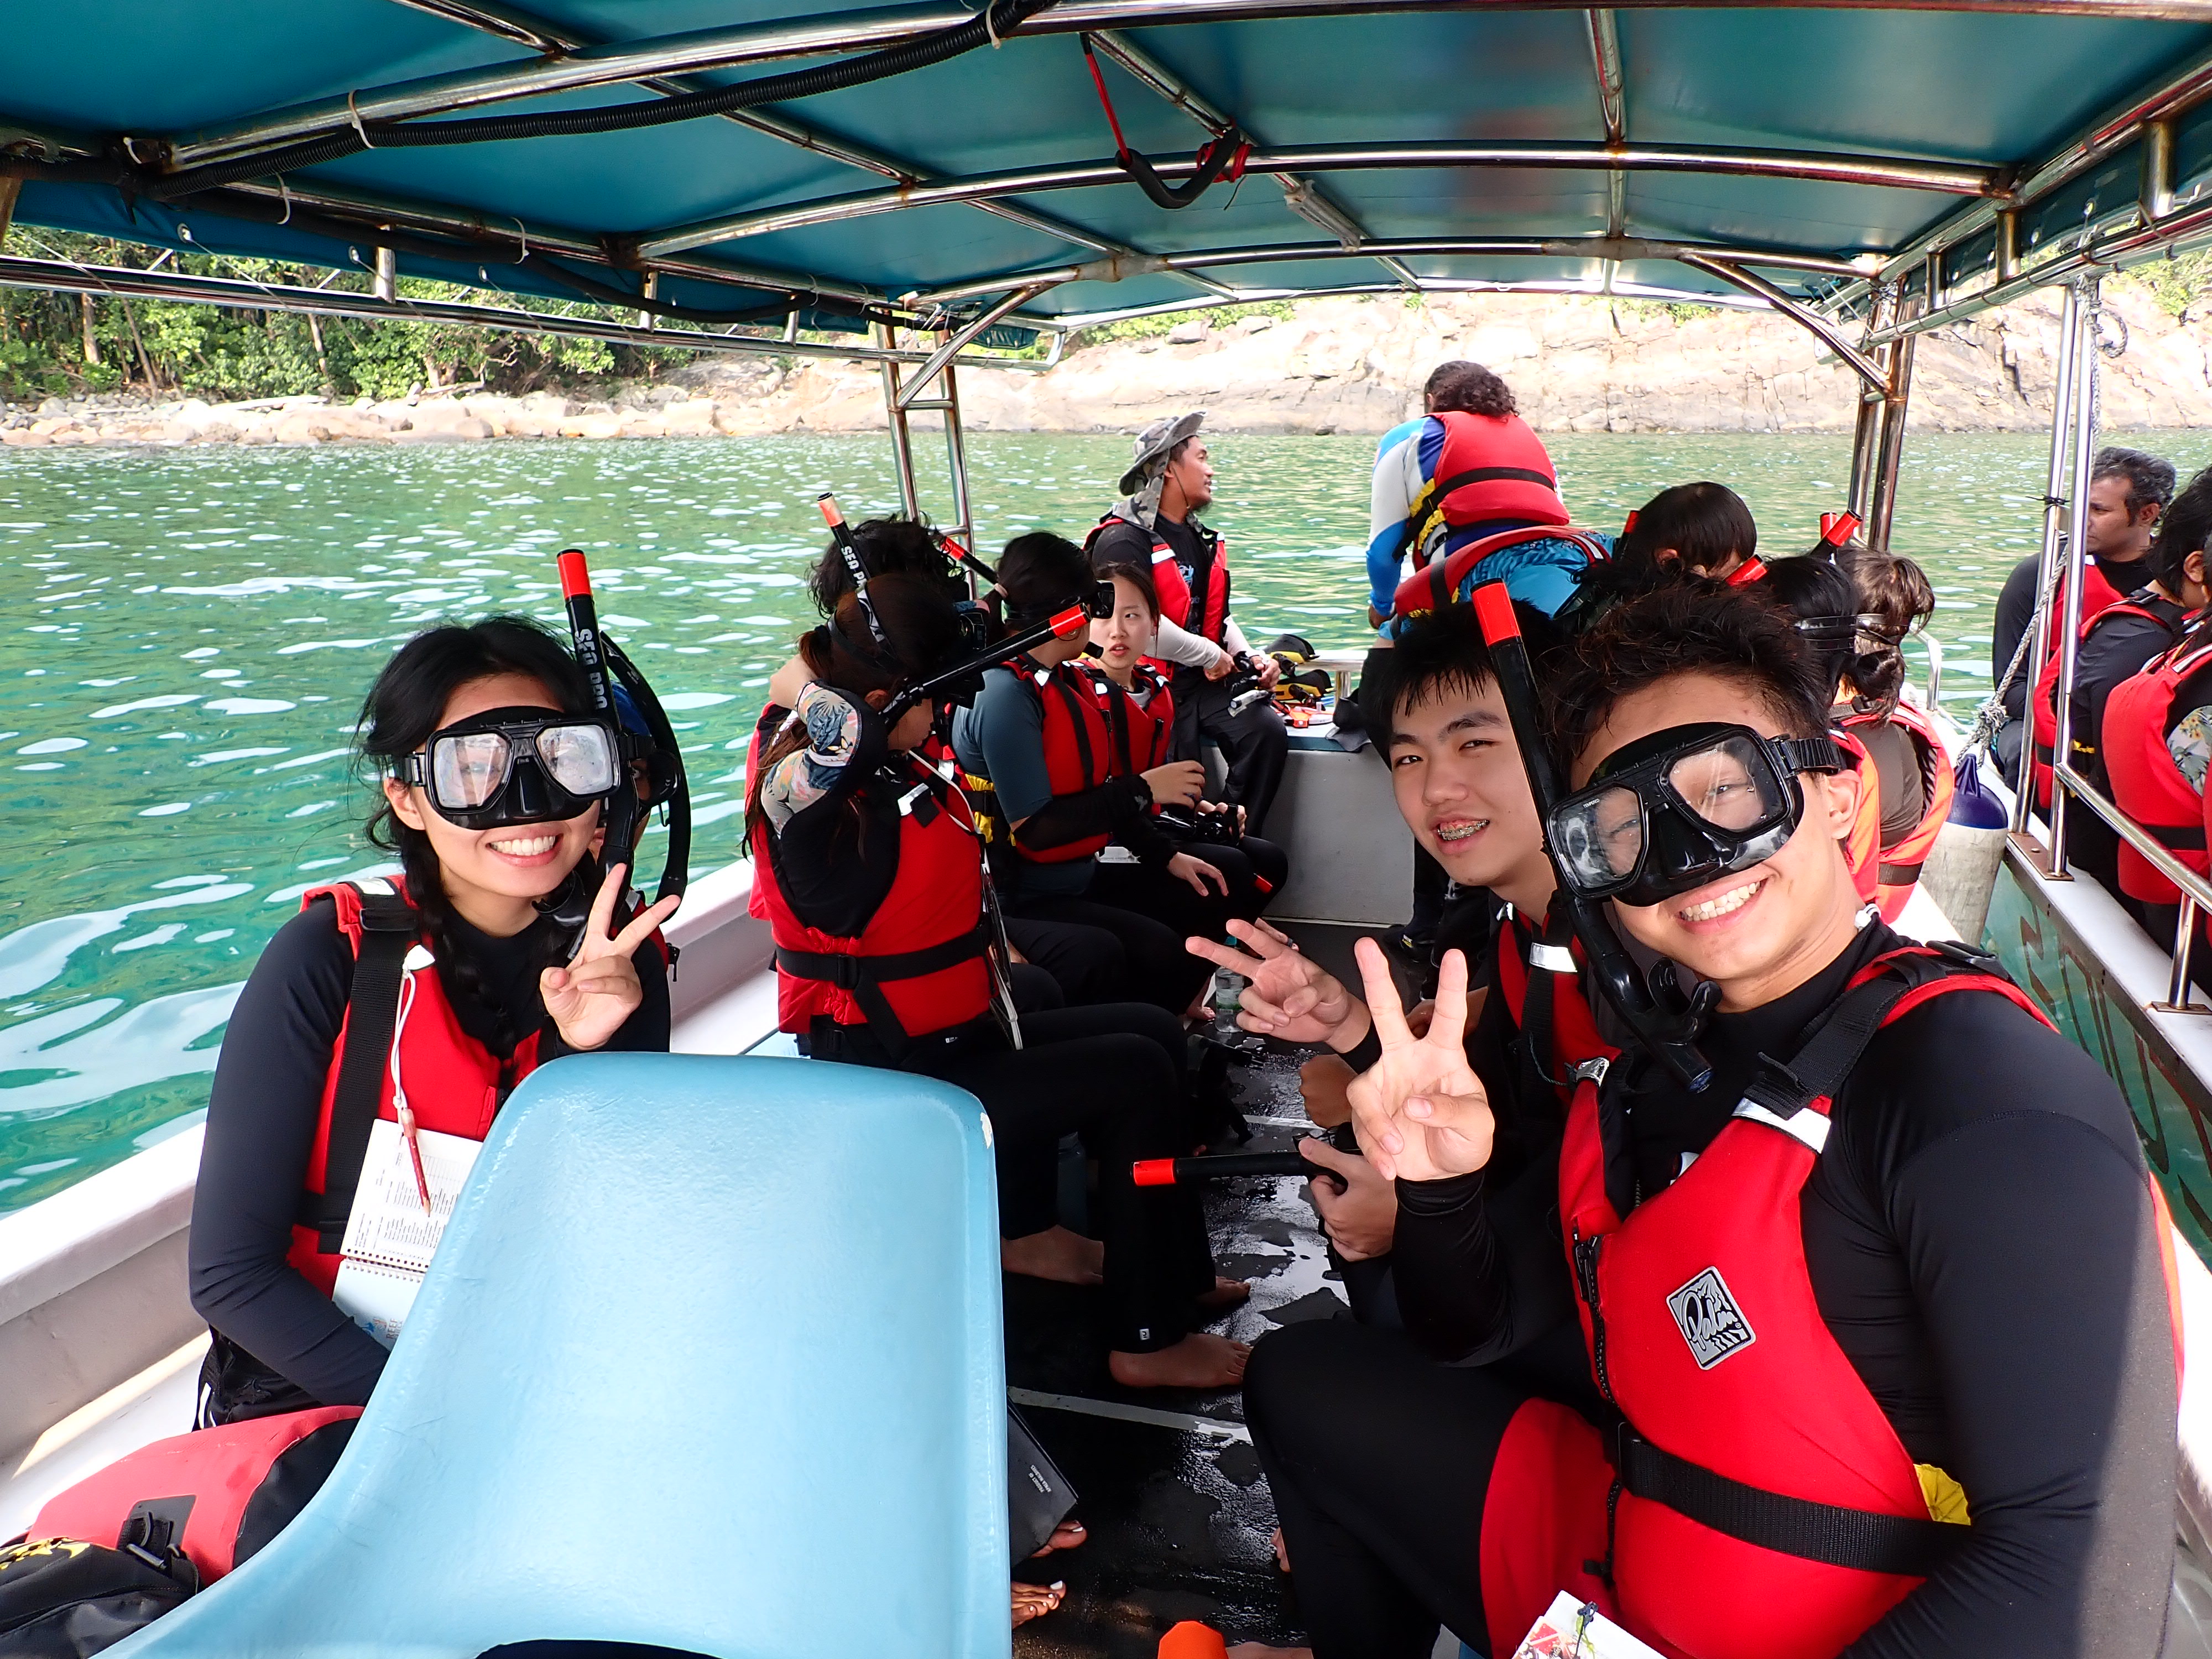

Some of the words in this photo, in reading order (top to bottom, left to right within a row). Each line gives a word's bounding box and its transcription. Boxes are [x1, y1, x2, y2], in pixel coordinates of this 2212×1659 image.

[841, 545, 859, 570] SEA
[575, 628, 598, 666] SEA
[386, 1318, 398, 1339] REEF
[1679, 1288, 1738, 1352] Palm
